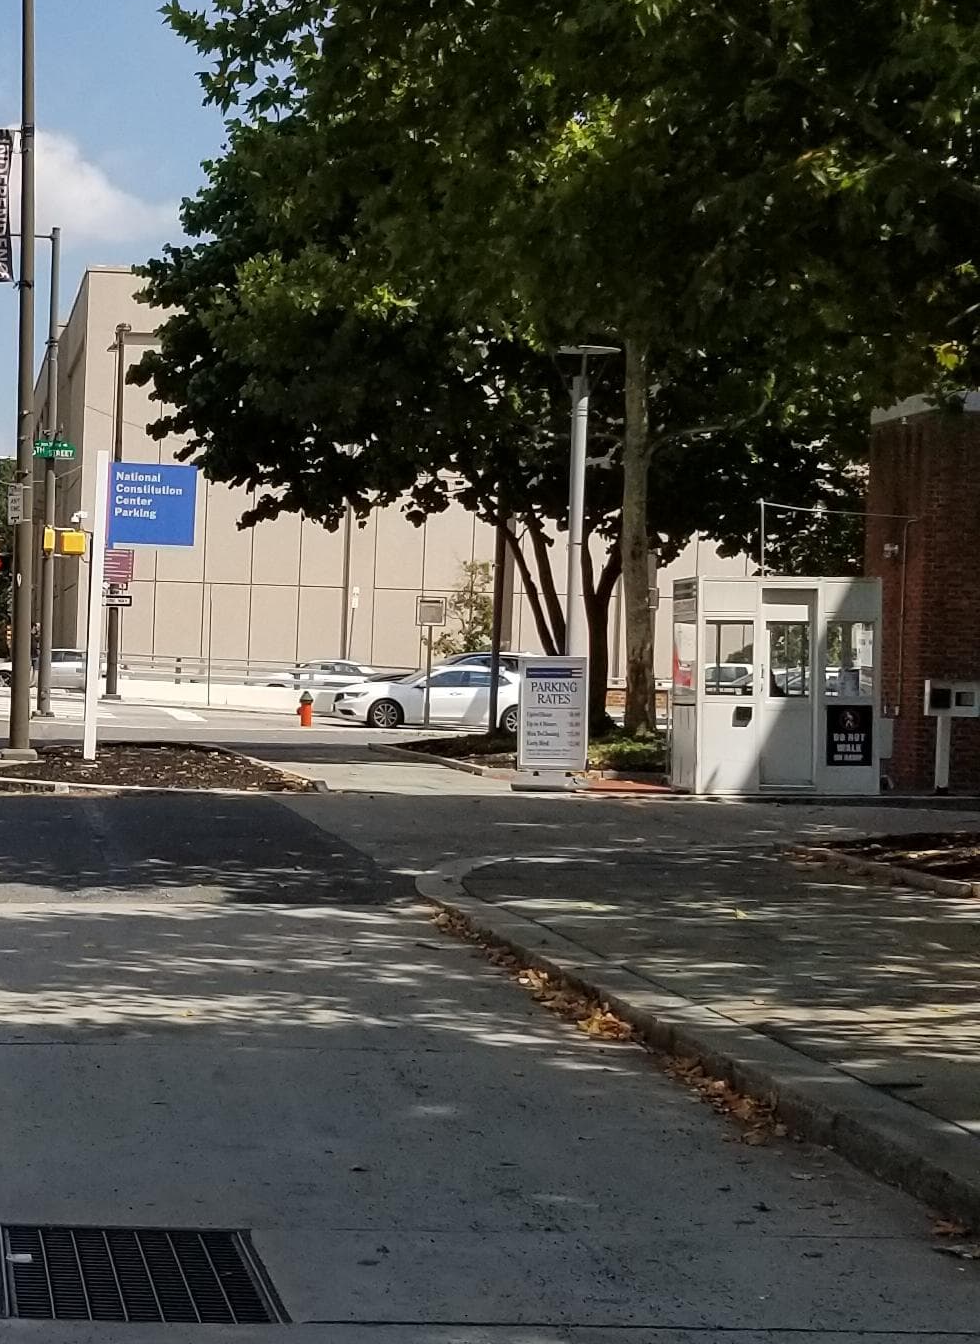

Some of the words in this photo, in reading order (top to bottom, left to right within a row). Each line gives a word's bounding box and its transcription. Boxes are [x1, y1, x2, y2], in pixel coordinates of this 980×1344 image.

[115, 471, 161, 482] National
[115, 483, 183, 496] Constitution
[115, 495, 153, 506] Center
[114, 507, 157, 520] Parking
[531, 682, 577, 692] PARKING
[537, 694, 571, 704] RATES
[833, 733, 846, 741] DO
[847, 733, 865, 741] NOT
[837, 744, 861, 752] WALK
